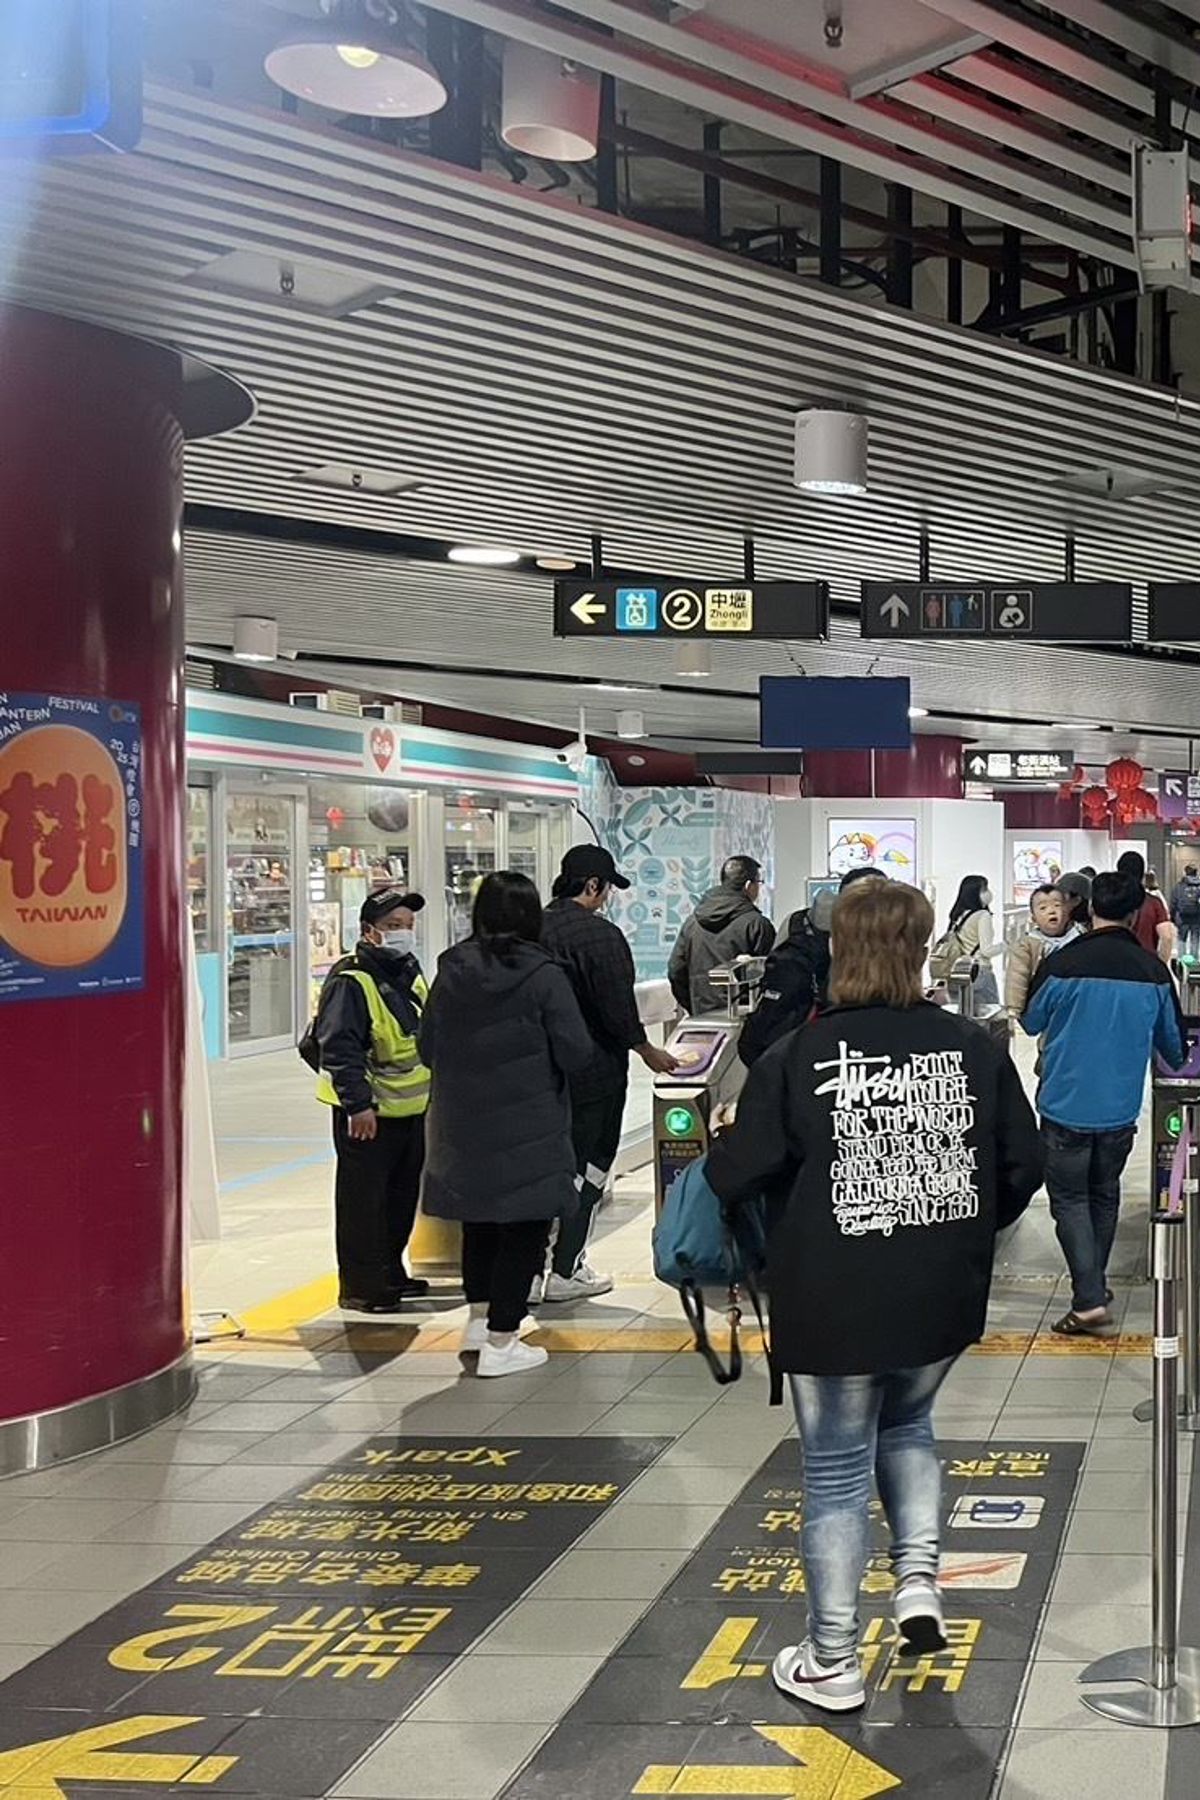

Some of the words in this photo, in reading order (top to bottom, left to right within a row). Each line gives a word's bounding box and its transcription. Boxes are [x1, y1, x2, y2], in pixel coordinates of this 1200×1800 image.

[710, 609, 748, 619] Zhongli
[47, 696, 100, 714] FESTIVAL
[16, 905, 108, 924] TAIWAN
[830, 1108, 873, 1140] FOR
[913, 1104, 974, 1136] WORLD
[353, 1447, 521, 1466] Xpark
[986, 1450, 1050, 1461] IKEA
[390, 1508, 463, 1521] Kong
[467, 1508, 530, 1521] Shn
[240, 1519, 475, 1543] 新光影城
[175, 1561, 482, 1587] 華泰名品城
[271, 1606, 454, 1633] EXIT
[107, 1604, 280, 1672] 2
[213, 1630, 429, 1679] 出口
[680, 1617, 766, 1690] 1
